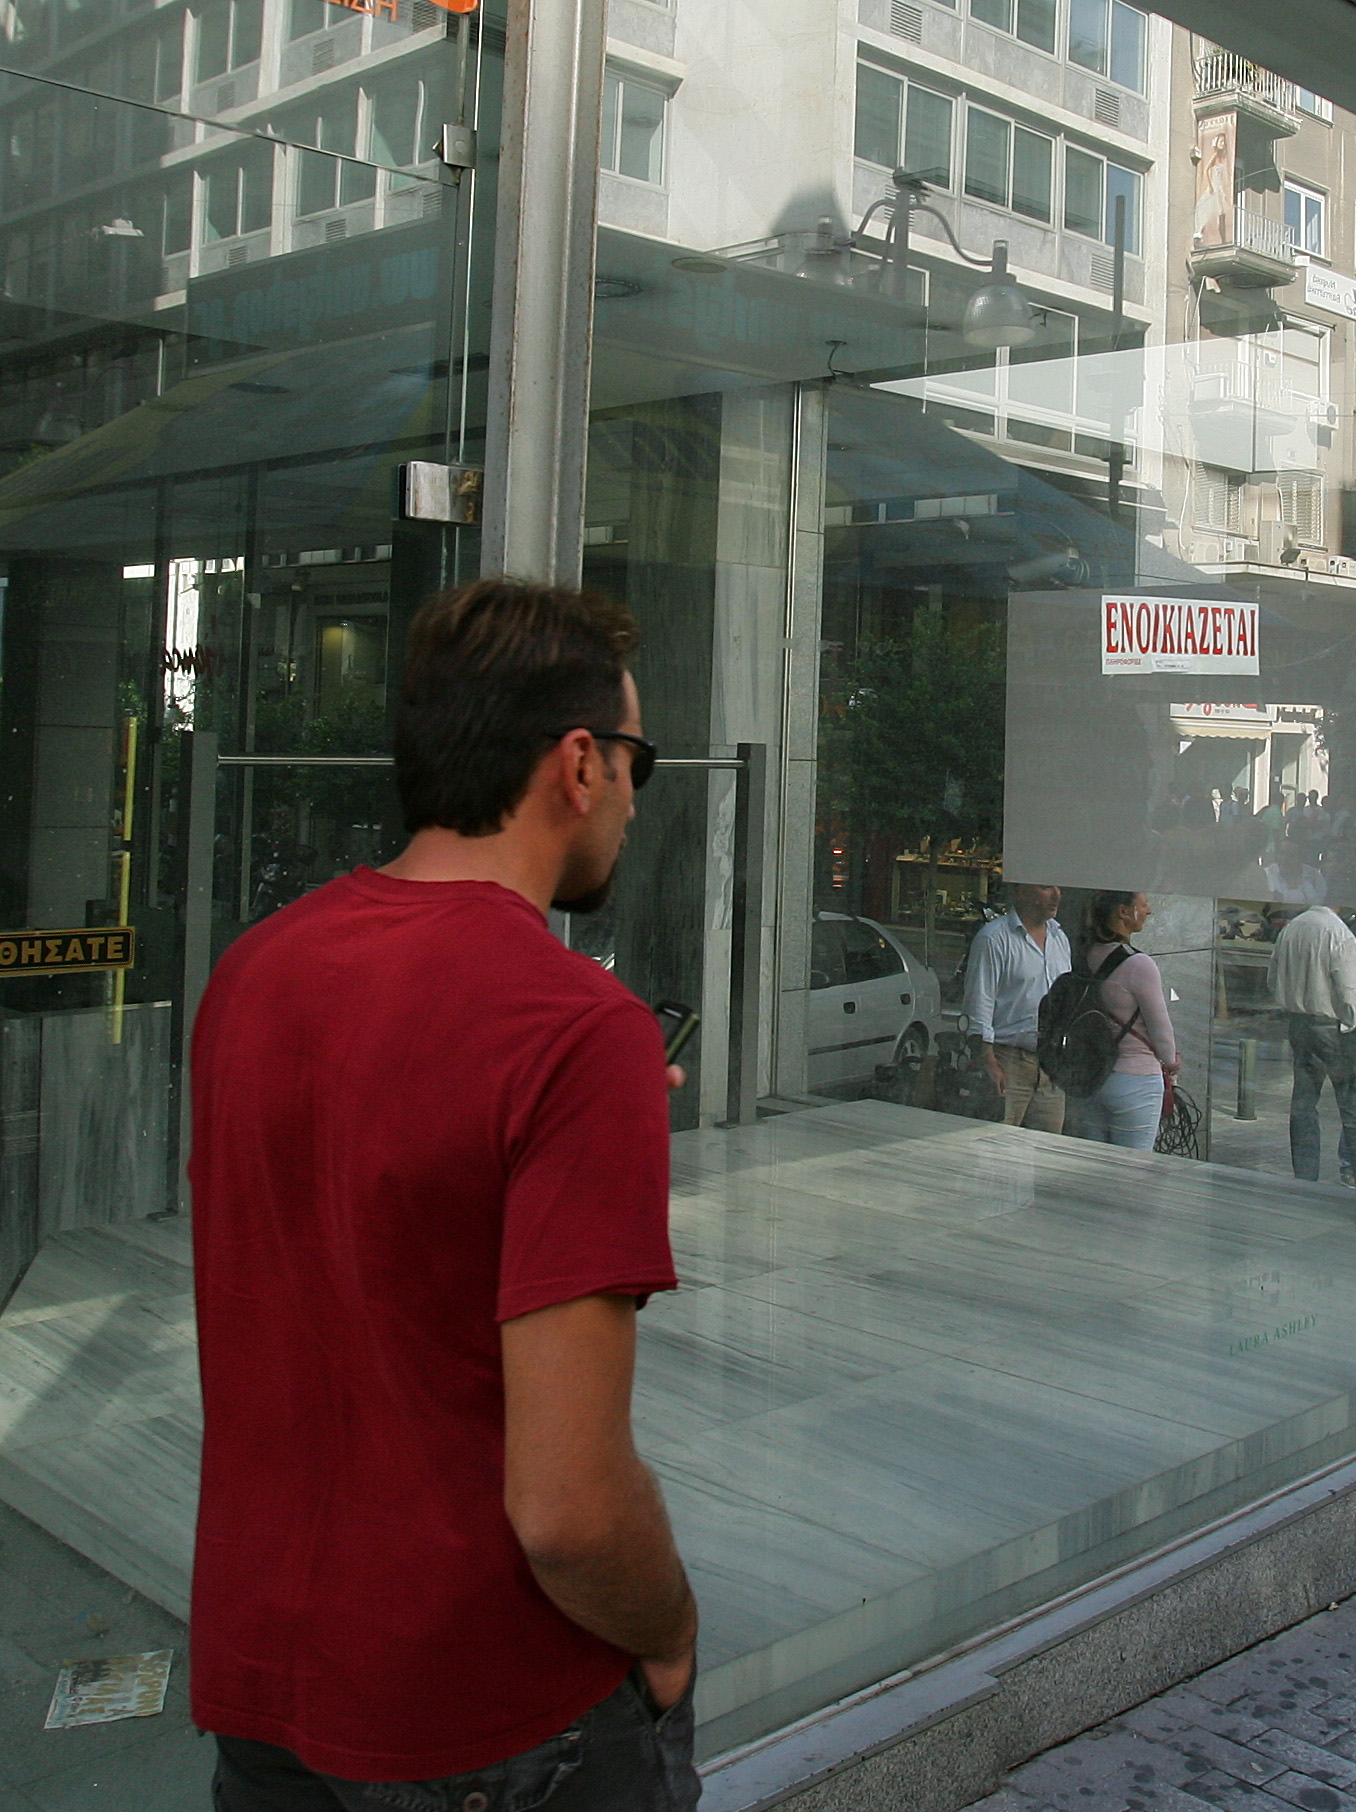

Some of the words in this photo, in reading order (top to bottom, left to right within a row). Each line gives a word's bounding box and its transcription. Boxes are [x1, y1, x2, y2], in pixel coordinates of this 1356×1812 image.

[1106, 602, 1256, 656] ΕΝΟΙΚΙΑΖΕΤΑΙ
[1229, 1331, 1270, 1358] LAURA
[1273, 1313, 1319, 1341] ASHLEY
